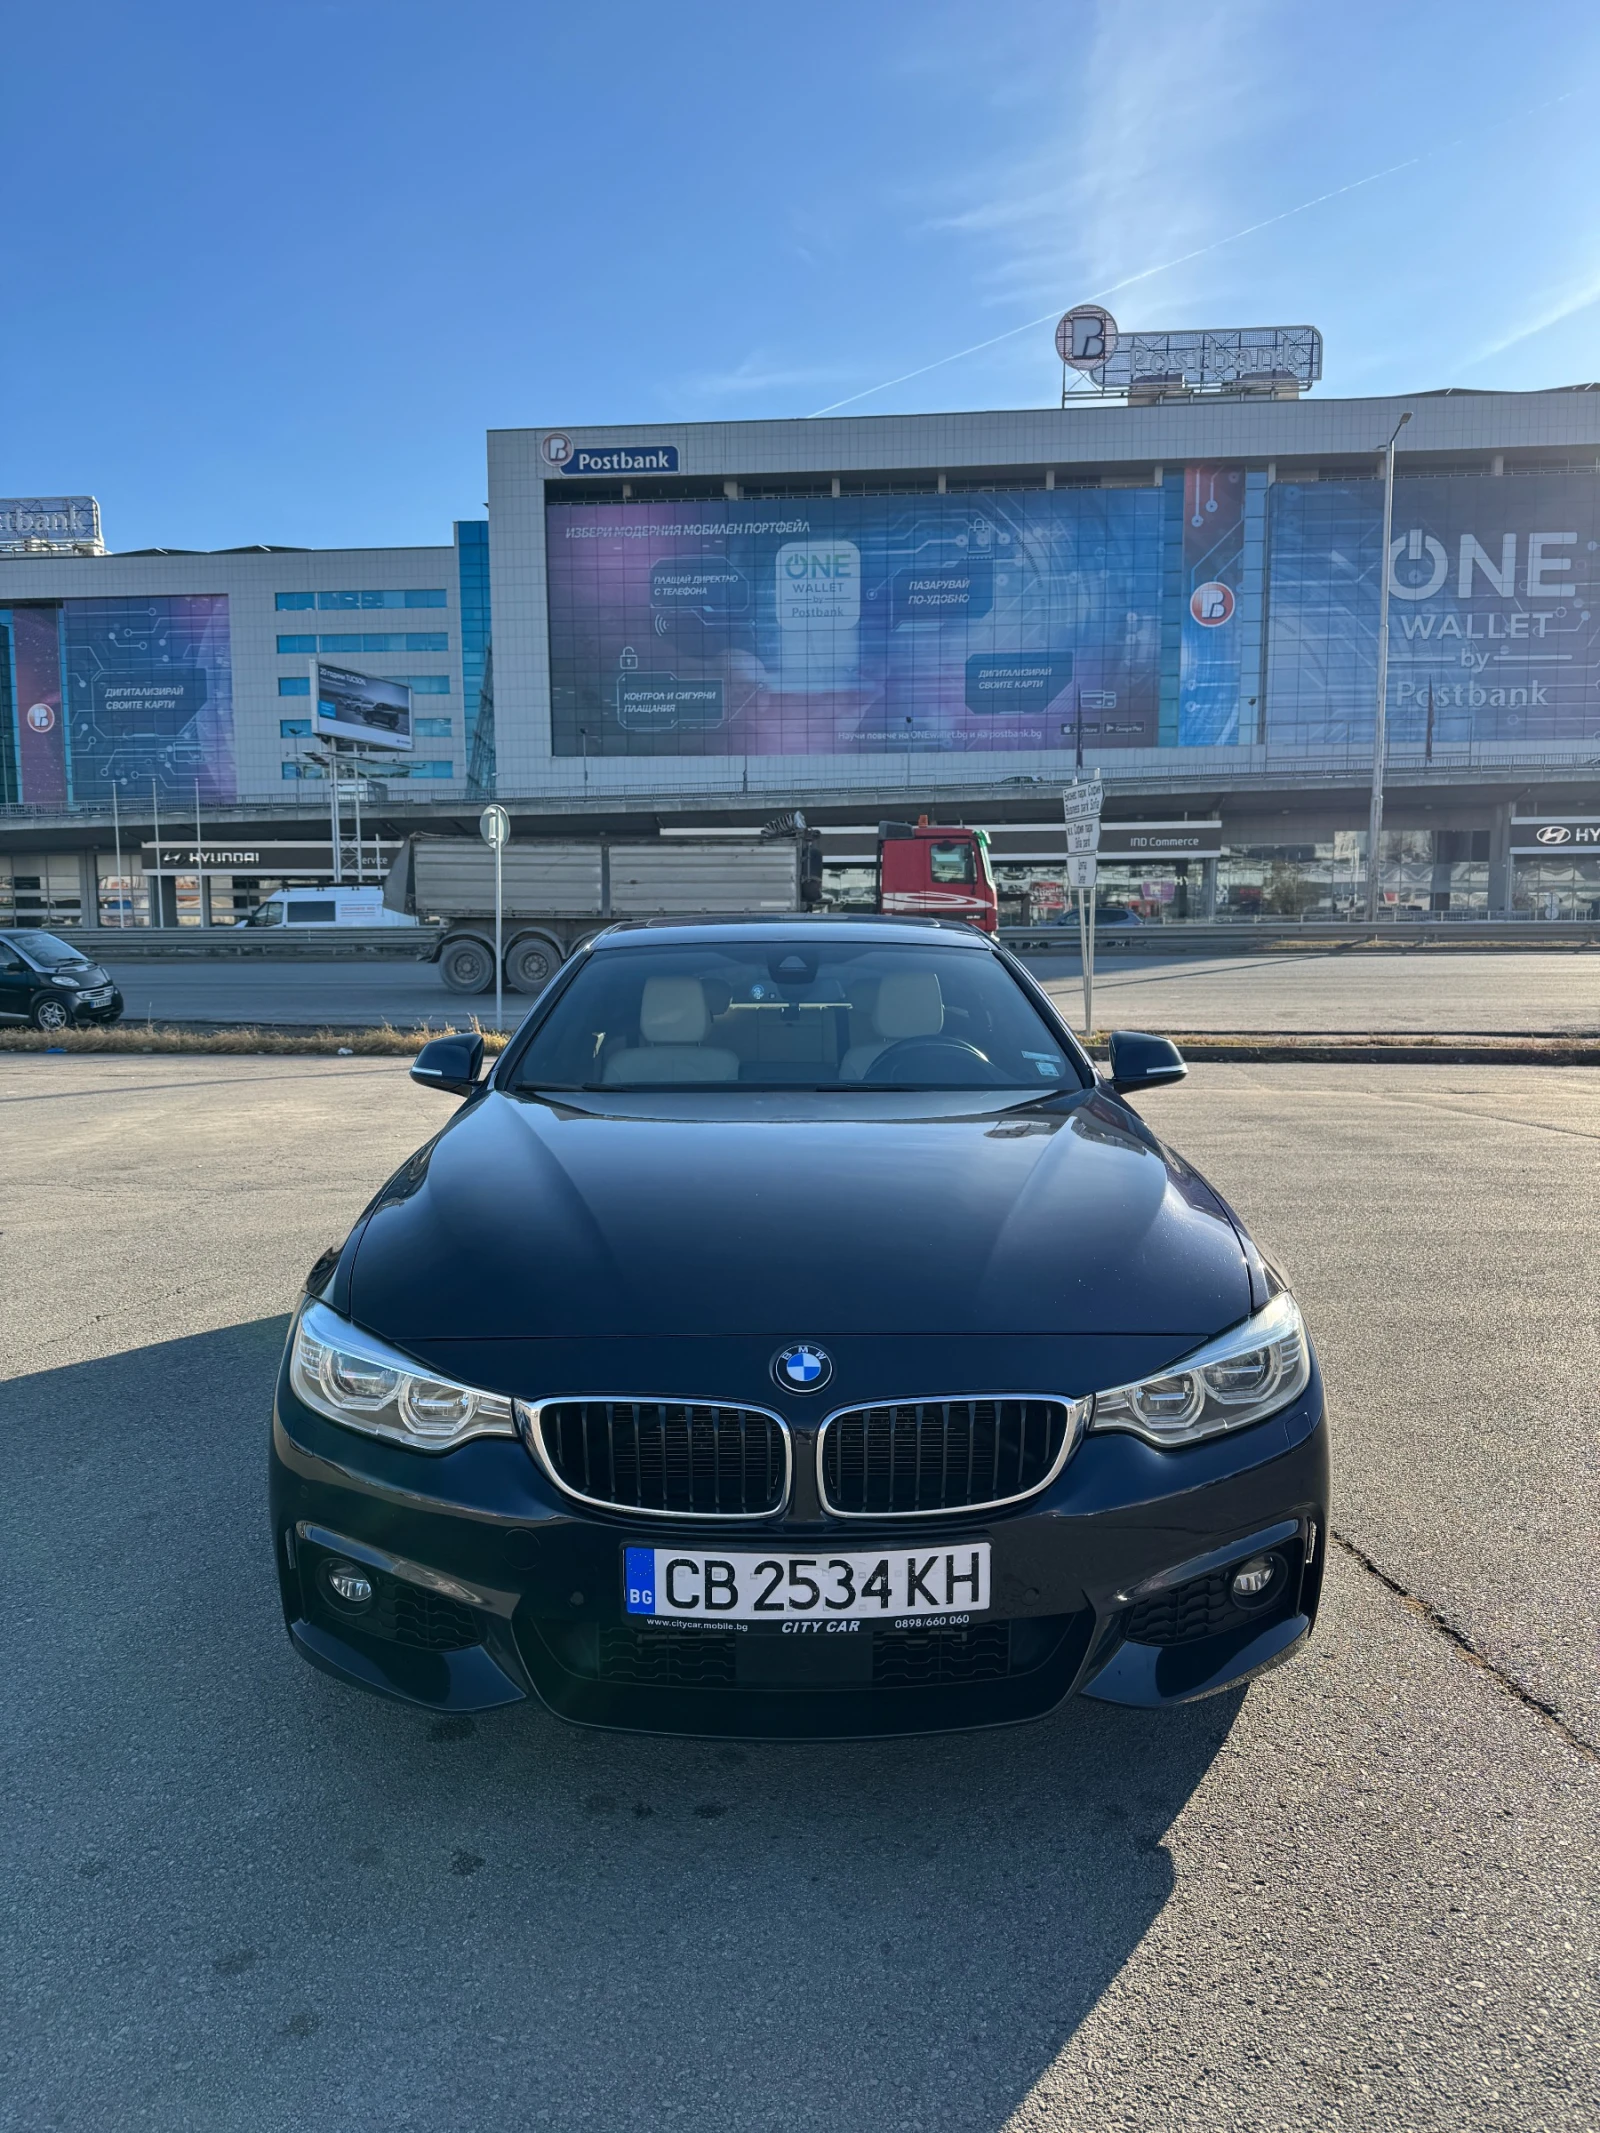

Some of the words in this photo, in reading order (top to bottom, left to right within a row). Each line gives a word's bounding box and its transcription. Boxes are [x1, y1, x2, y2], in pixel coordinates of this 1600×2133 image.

[1130, 337, 1301, 375] Postbank
[579, 451, 669, 470] Postbank
[566, 527, 612, 538] ИЗБЕРИ
[614, 525, 682, 538] МОДЕРНИЯ
[684, 523, 742, 536] МОБИЛЕН
[744, 519, 810, 534] ПОРТФЕЙЛ
[784, 554, 851, 579] ONE
[1389, 529, 1577, 600] ONE
[654, 575, 691, 585] ПЛАЩАЙ
[692, 575, 738, 585] ДИРЕКТНО
[909, 578, 970, 590] ПАЗАРУВАЙ
[662, 587, 707, 596] ТЕЛЕФОНА
[793, 583, 844, 593] WALLET
[812, 596, 824, 604] by
[908, 594, 970, 606] ПО-УДОБНО
[792, 607, 844, 618] Postbank
[1402, 613, 1554, 640] WALLET
[1460, 649, 1490, 673] by
[978, 667, 1052, 678] ДИГИТАЛИЗИРАЙ
[979, 681, 1013, 689] СВОИТЕ
[1014, 680, 1044, 688] КАРТИ
[105, 685, 184, 698] ДИГИТАЛИЗИРАЙ
[624, 692, 664, 701] КОНТРОЛ
[667, 692, 674, 700] И
[675, 691, 716, 700] СИГУРНИ
[1397, 680, 1548, 708] Postbank
[106, 701, 143, 709] СВОИТЕ
[144, 700, 176, 709] КАРТИ
[624, 704, 676, 713] ПЛАЩАНИЯ
[1149, 837, 1199, 847] Commerce
[189, 852, 260, 863] HYUNDAI
[781, 1345, 827, 1360] BMW
[665, 1558, 739, 1610] CB
[753, 1559, 893, 1611] 2534
[907, 1552, 980, 1607] KH
[629, 1590, 652, 1604] BG
[647, 1618, 748, 1632] www.citycar.mobile.bg
[782, 1620, 822, 1633] CITY
[826, 1620, 860, 1632] CAR
[895, 1616, 947, 1629] 0898/660
[949, 1614, 970, 1626] 060
